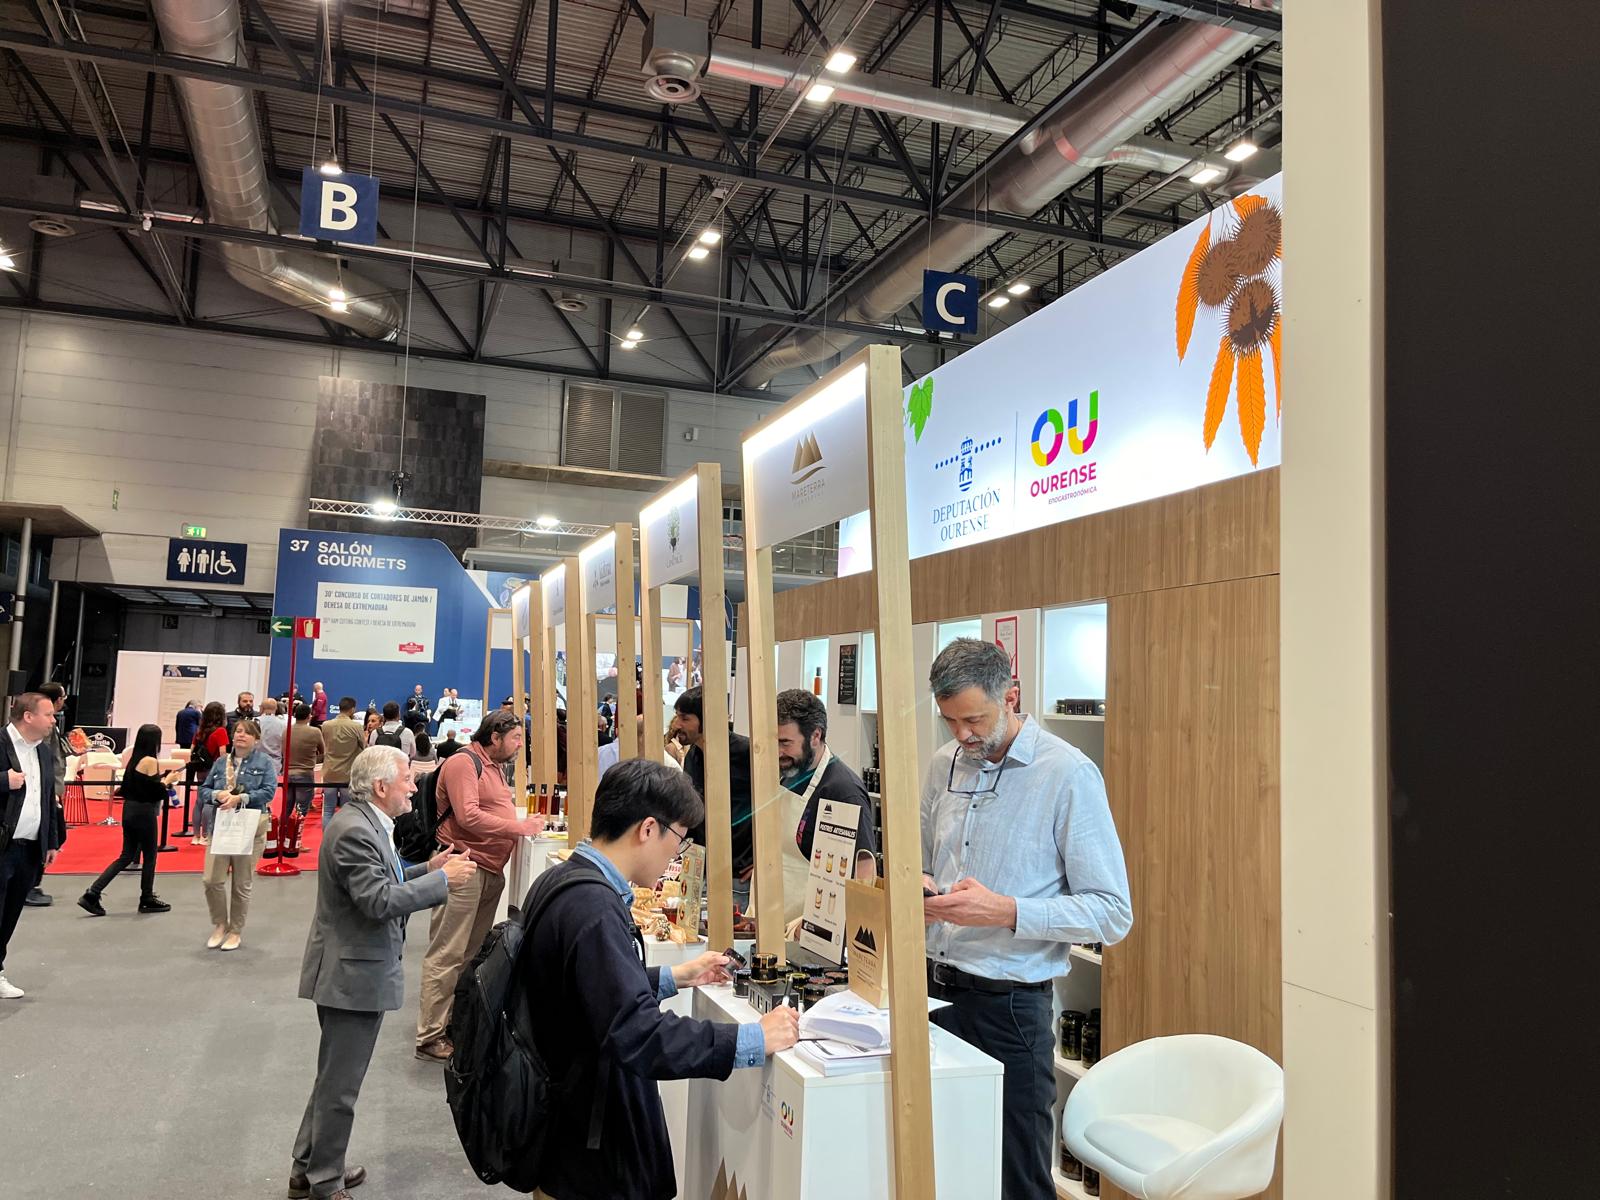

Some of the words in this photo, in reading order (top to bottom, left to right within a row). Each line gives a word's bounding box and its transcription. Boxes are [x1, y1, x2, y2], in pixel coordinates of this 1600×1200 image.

[320, 181, 358, 231] B
[936, 282, 967, 325] C
[1031, 389, 1099, 467] OU
[1030, 462, 1097, 498] OURENSE
[933, 487, 1001, 525] DEPUTACIÓN
[940, 514, 989, 542] OURENSE
[290, 540, 310, 552] 37
[318, 541, 372, 556] SALÓN
[317, 554, 407, 570] GOURMETS
[324, 601, 343, 609] DEHESA
[345, 602, 352, 610] DE
[352, 602, 389, 611] EXTREMADURA
[335, 591, 361, 599] CONCURSO
[370, 593, 402, 601] CORTADORES
[403, 594, 410, 602] DE
[411, 594, 429, 603] JAMÓN
[781, 1101, 794, 1126] OU
